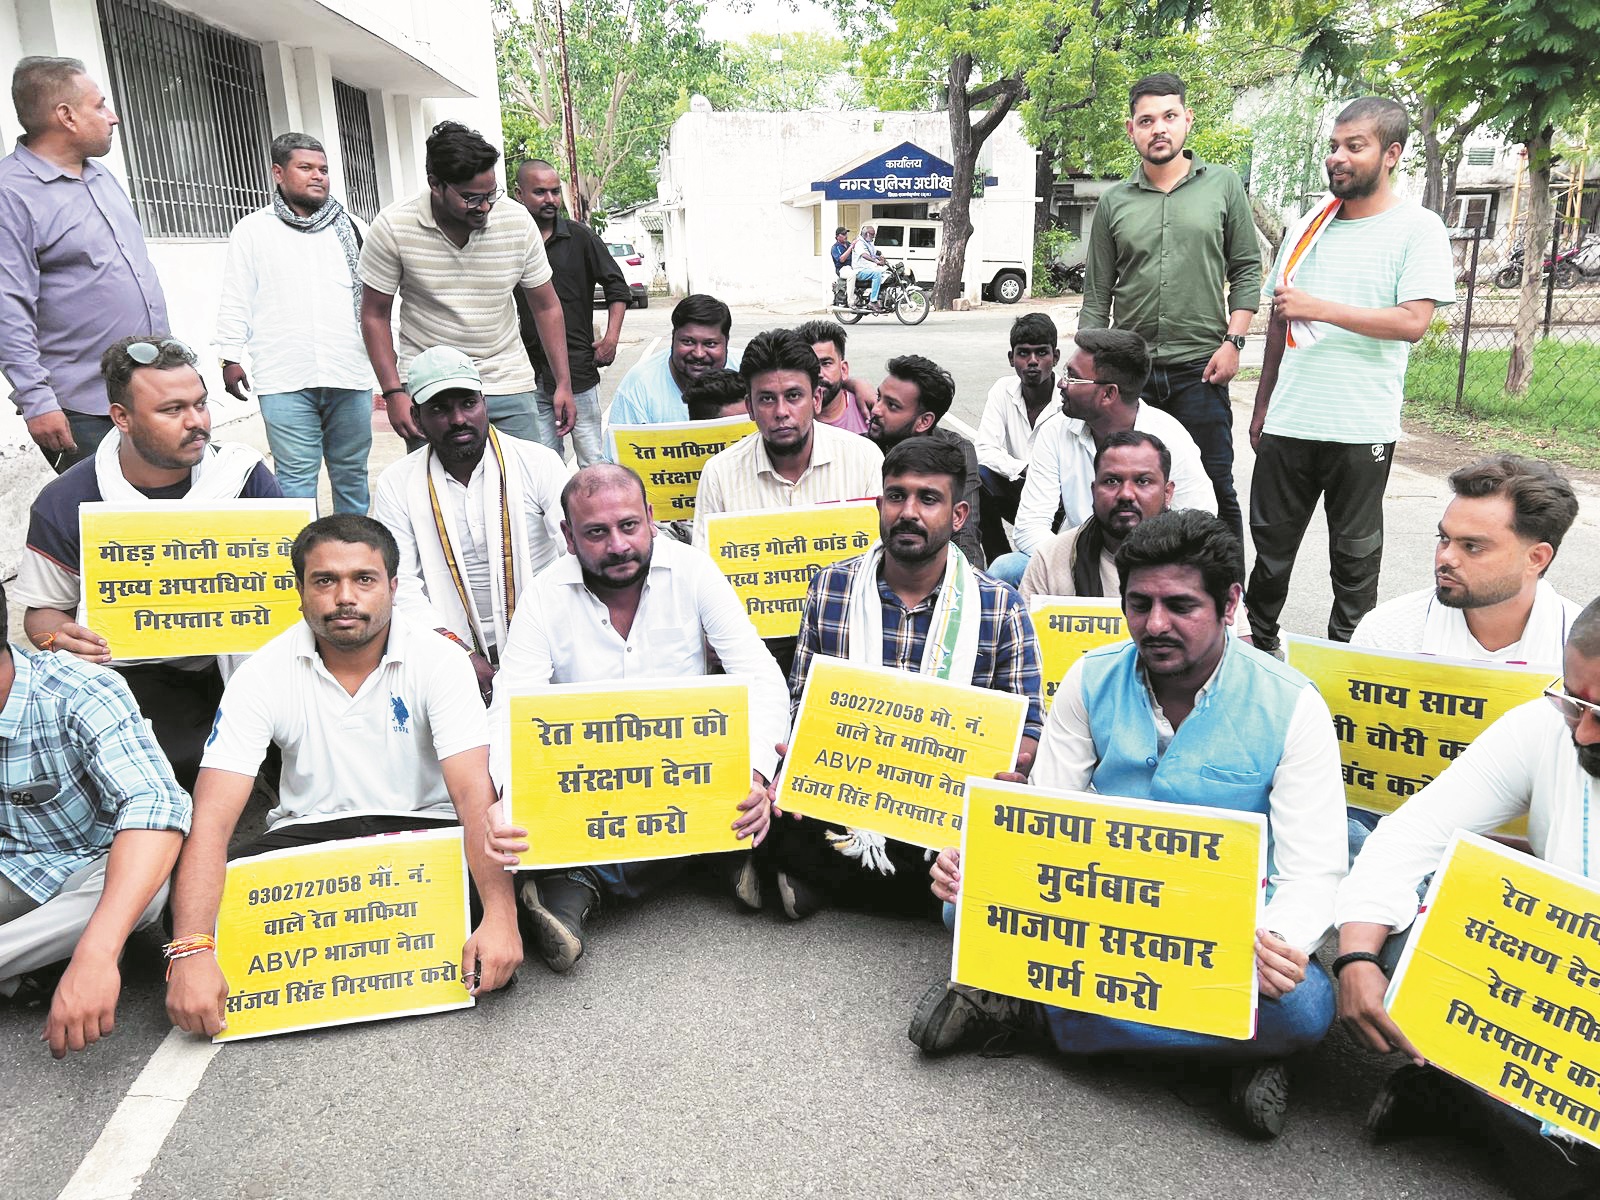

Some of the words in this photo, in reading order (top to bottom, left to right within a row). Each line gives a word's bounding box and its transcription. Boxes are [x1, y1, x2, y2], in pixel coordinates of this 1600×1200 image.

[885, 156, 922, 169] कार्यालय
[840, 178, 872, 191] नगर
[873, 174, 912, 193] पुलिस
[913, 173, 954, 191] अधीक्ष
[629, 443, 656, 460] रेत
[99, 540, 156, 567] मोहड़
[162, 539, 218, 560] गोली
[226, 538, 270, 559] कांड
[720, 541, 760, 562] मोहड़
[766, 536, 807, 556] गोली
[813, 533, 848, 552] कांड
[852, 531, 869, 549] के
[98, 579, 152, 604] मुख्य
[159, 572, 269, 596] अपराधियों
[134, 610, 224, 631] गिरफ्तार
[230, 605, 271, 626] करो
[746, 597, 806, 616] गिरफ्ता
[1049, 614, 1122, 635] भाजपा
[829, 690, 924, 723] 9302727058
[1348, 679, 1411, 709] साय
[1419, 689, 1488, 720] साय
[532, 717, 574, 745] रेत
[582, 713, 684, 743] माफिया
[692, 709, 728, 736] को
[835, 722, 870, 742] वाले
[873, 725, 897, 748] रेत
[901, 737, 967, 764] माफिया
[1366, 722, 1428, 757] चोरी
[557, 764, 654, 793] संरक्षण
[661, 758, 713, 786] देना
[814, 749, 872, 774] ABVP
[876, 763, 934, 789] भाजपा
[791, 775, 834, 799] संजय
[837, 783, 872, 807] सिंह
[875, 792, 947, 827] गिरफ्तार
[586, 810, 627, 839] बंद
[636, 805, 688, 835] करो
[994, 804, 1096, 844] भाजपा
[1106, 819, 1225, 861] सरकार
[248, 875, 362, 906] 9302727058
[1037, 861, 1165, 908] मुर्दाबाद
[1501, 877, 1541, 917] रेत
[264, 912, 305, 936] वाले
[308, 909, 338, 929] रेत
[344, 901, 418, 924] माफिया
[987, 904, 1090, 949] भाजपा
[1099, 923, 1218, 969] सरकार
[247, 946, 318, 976] ABVP
[324, 938, 391, 962] भाजपा
[396, 932, 435, 952] नेता
[1464, 917, 1562, 974] संरक्षण
[226, 989, 280, 1014] संजय
[286, 979, 327, 1004] सिंह
[332, 970, 414, 997] गिरफ्तार
[420, 960, 459, 984] करो
[1027, 959, 1085, 997] शर्म
[1095, 971, 1162, 1012] करो
[1487, 967, 1527, 1009] रेत
[1446, 998, 1563, 1074] गिरफ्तार
[1499, 1061, 1600, 1132] गिरफ्ता
